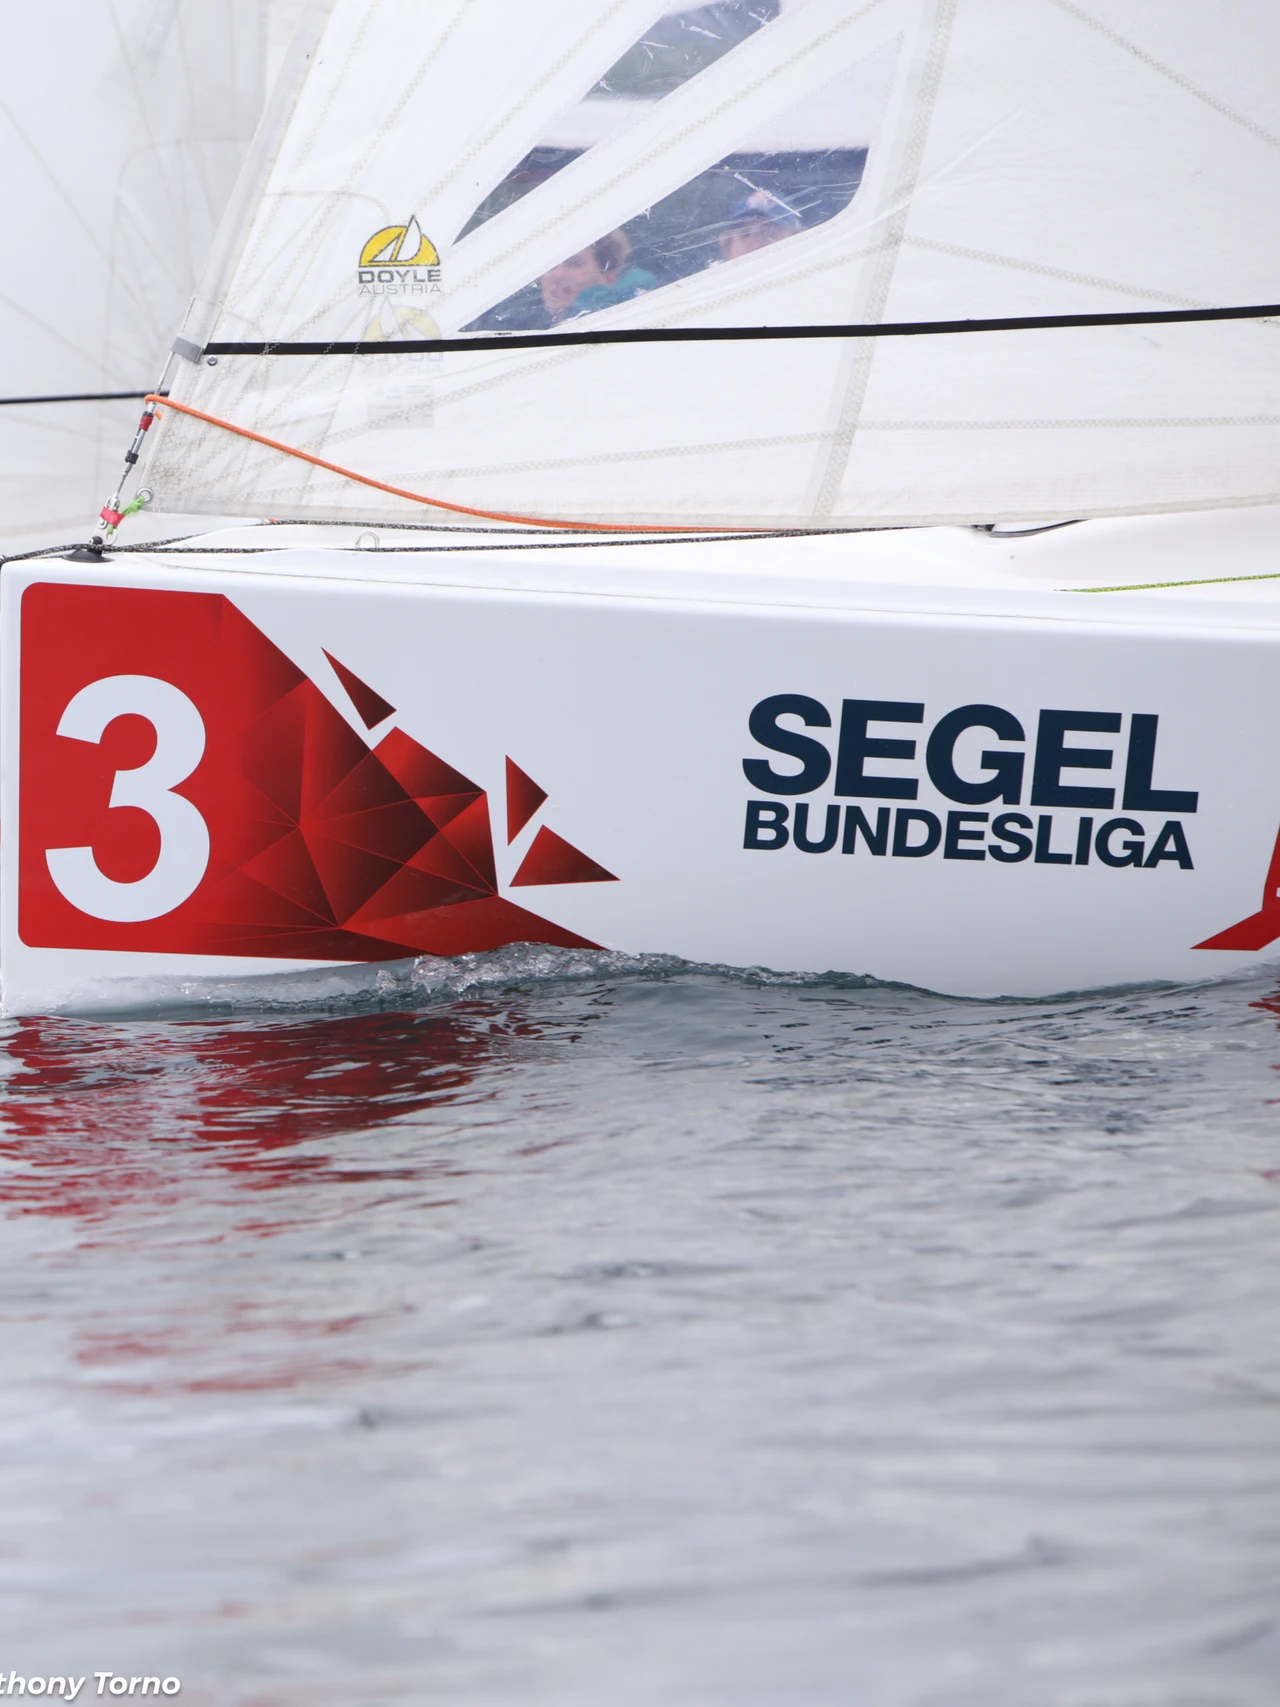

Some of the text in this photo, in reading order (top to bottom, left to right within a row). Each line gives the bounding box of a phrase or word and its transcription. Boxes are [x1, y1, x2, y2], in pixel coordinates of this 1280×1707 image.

[358, 269, 442, 283] DOYLE
[359, 284, 442, 296] AUSTRIA
[742, 693, 1199, 814] SEGEL
[45, 674, 210, 923] 3
[742, 799, 1195, 870] BUNDESLIGA
